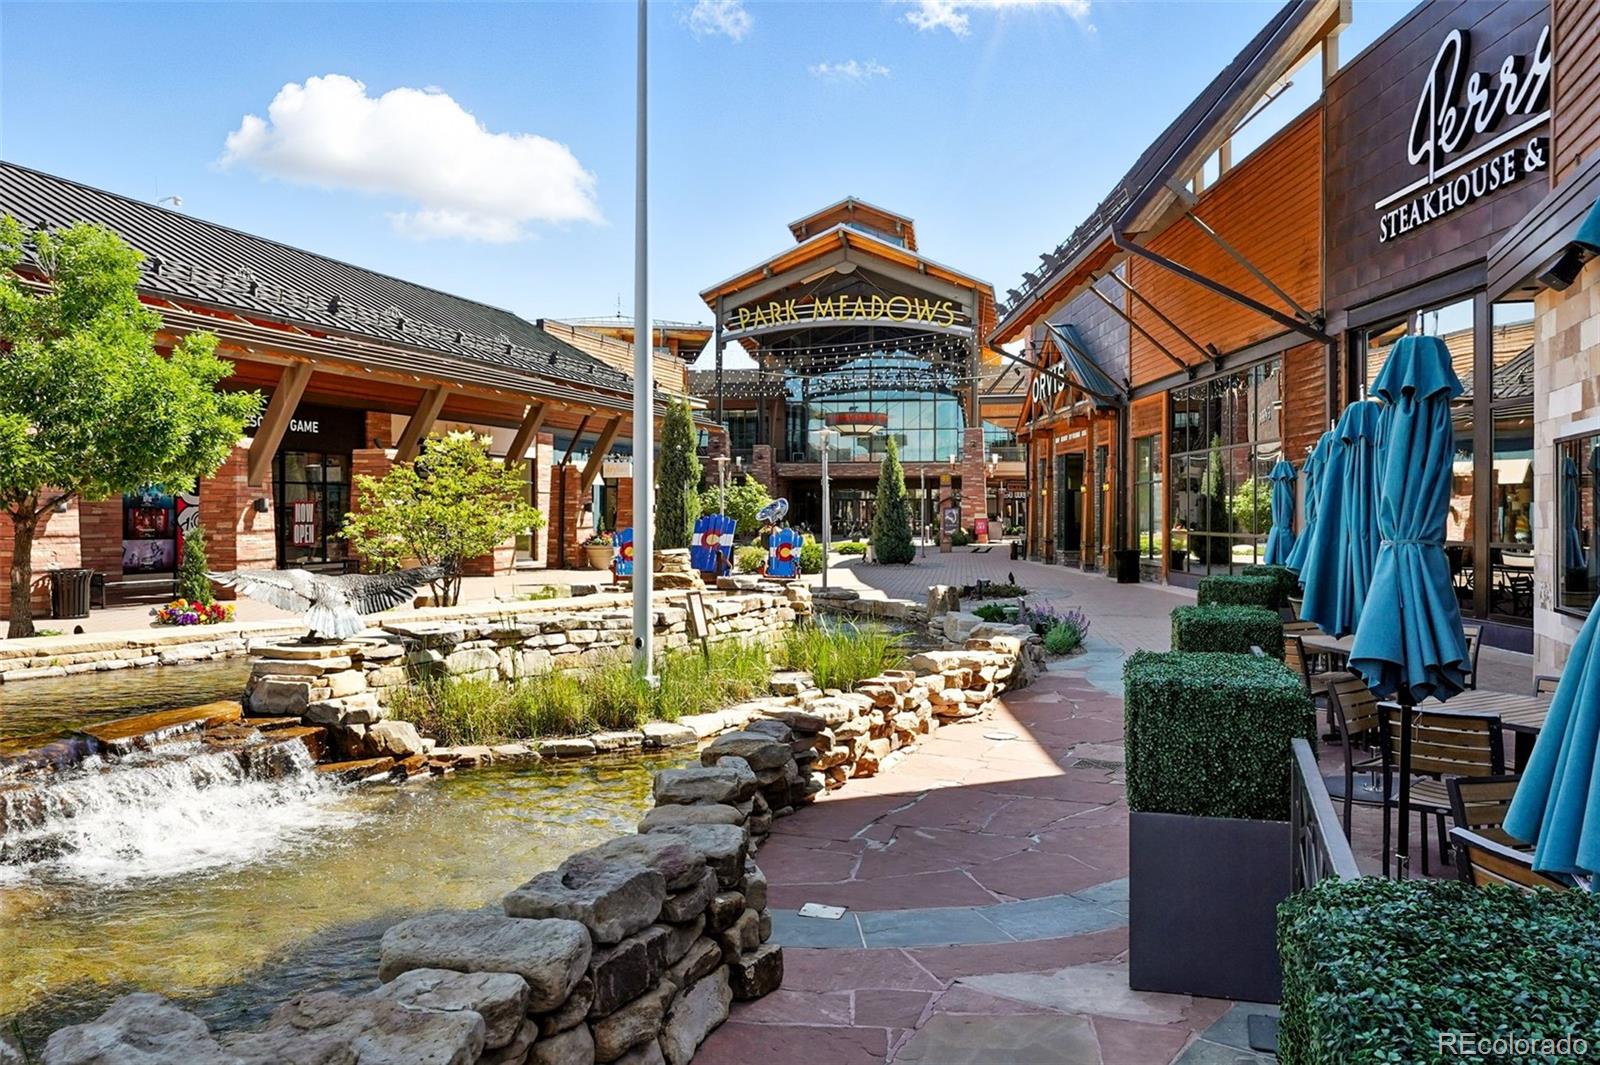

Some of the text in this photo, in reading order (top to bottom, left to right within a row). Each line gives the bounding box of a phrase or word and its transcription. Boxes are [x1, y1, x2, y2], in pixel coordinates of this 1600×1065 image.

[1379, 138, 1546, 243] STEAKHOUSE &
[738, 294, 955, 331] PARK MEADOWS
[1032, 360, 1066, 403] ORVIS
[290, 419, 319, 433] GAME
[295, 503, 314, 522] NOW
[294, 524, 314, 544] OPEN
